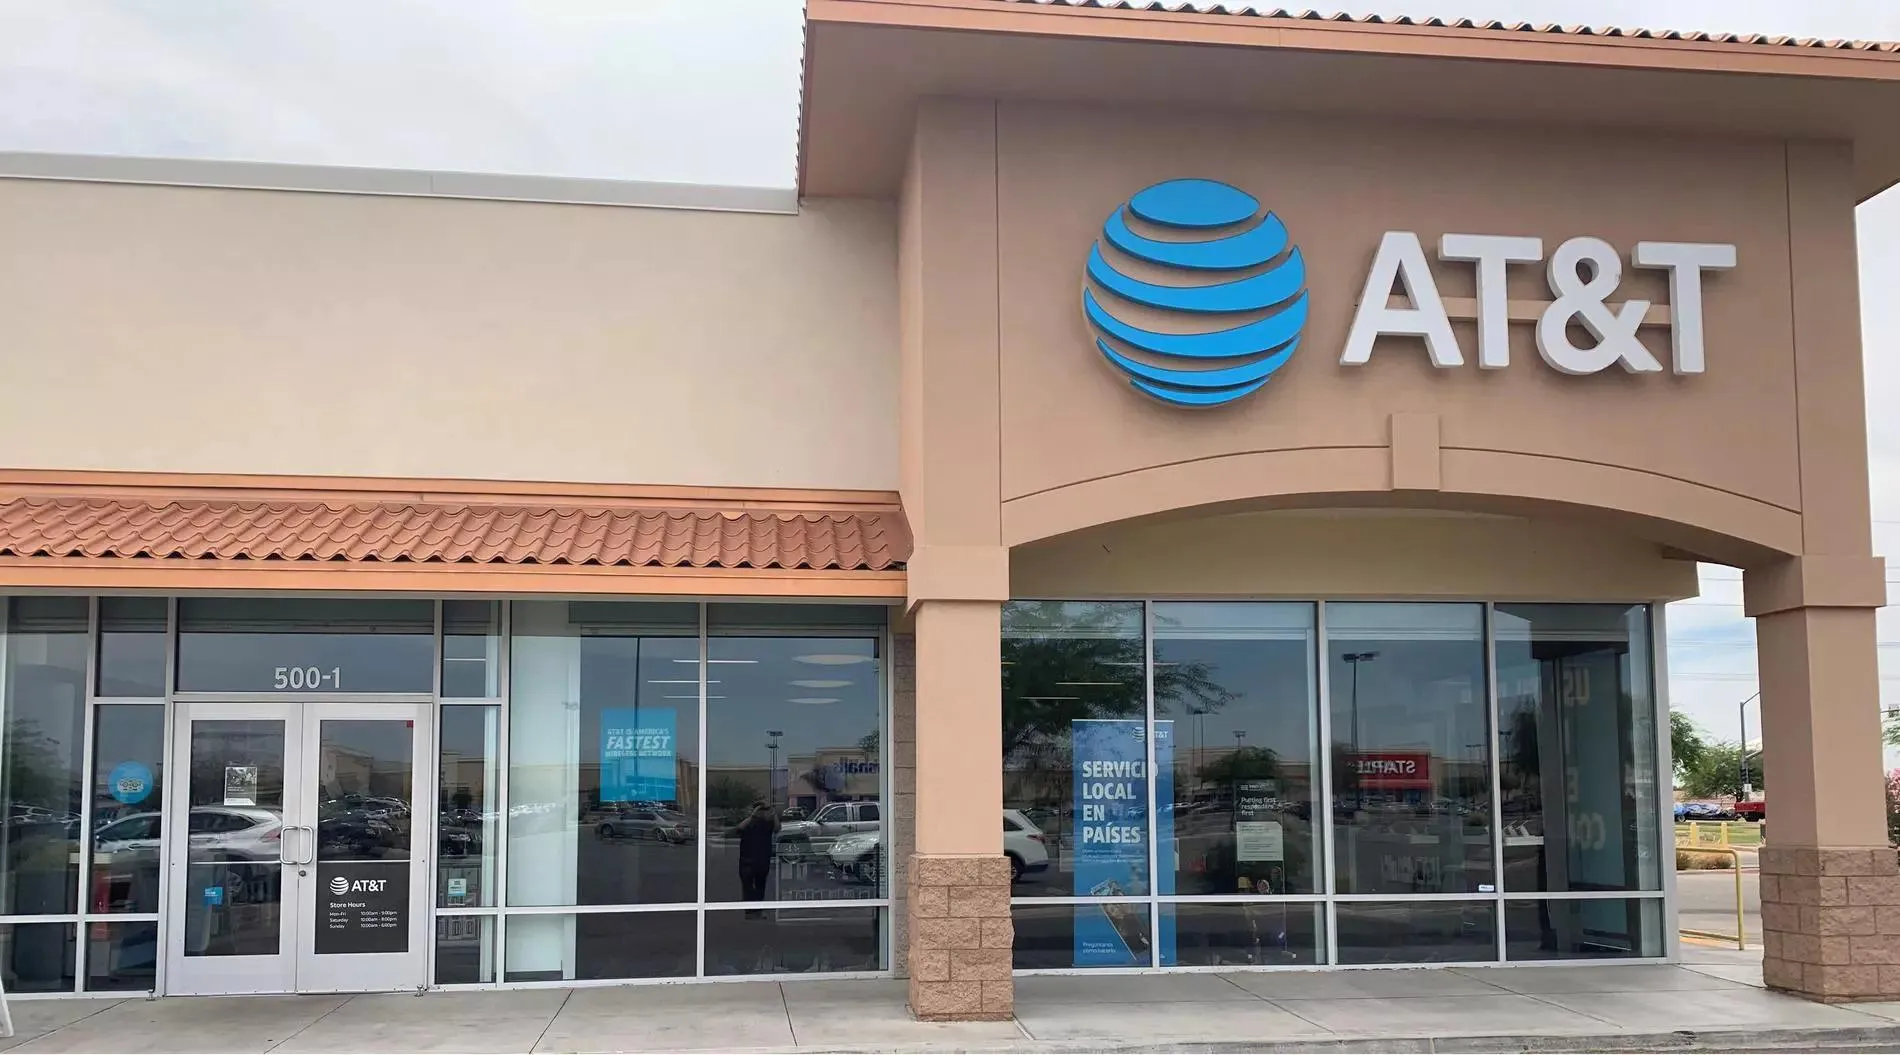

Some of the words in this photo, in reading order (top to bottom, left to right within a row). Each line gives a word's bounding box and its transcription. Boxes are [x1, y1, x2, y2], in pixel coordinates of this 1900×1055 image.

[1340, 231, 1737, 375] AT&T
[274, 667, 341, 689] 500-1
[607, 735, 671, 749] FASTEST
[1082, 761, 1158, 778] SERVICI
[1082, 783, 1137, 800] LOCAL
[1083, 804, 1105, 822] EN
[1082, 822, 1141, 844] PAÍSES
[351, 880, 387, 891] AT&T
